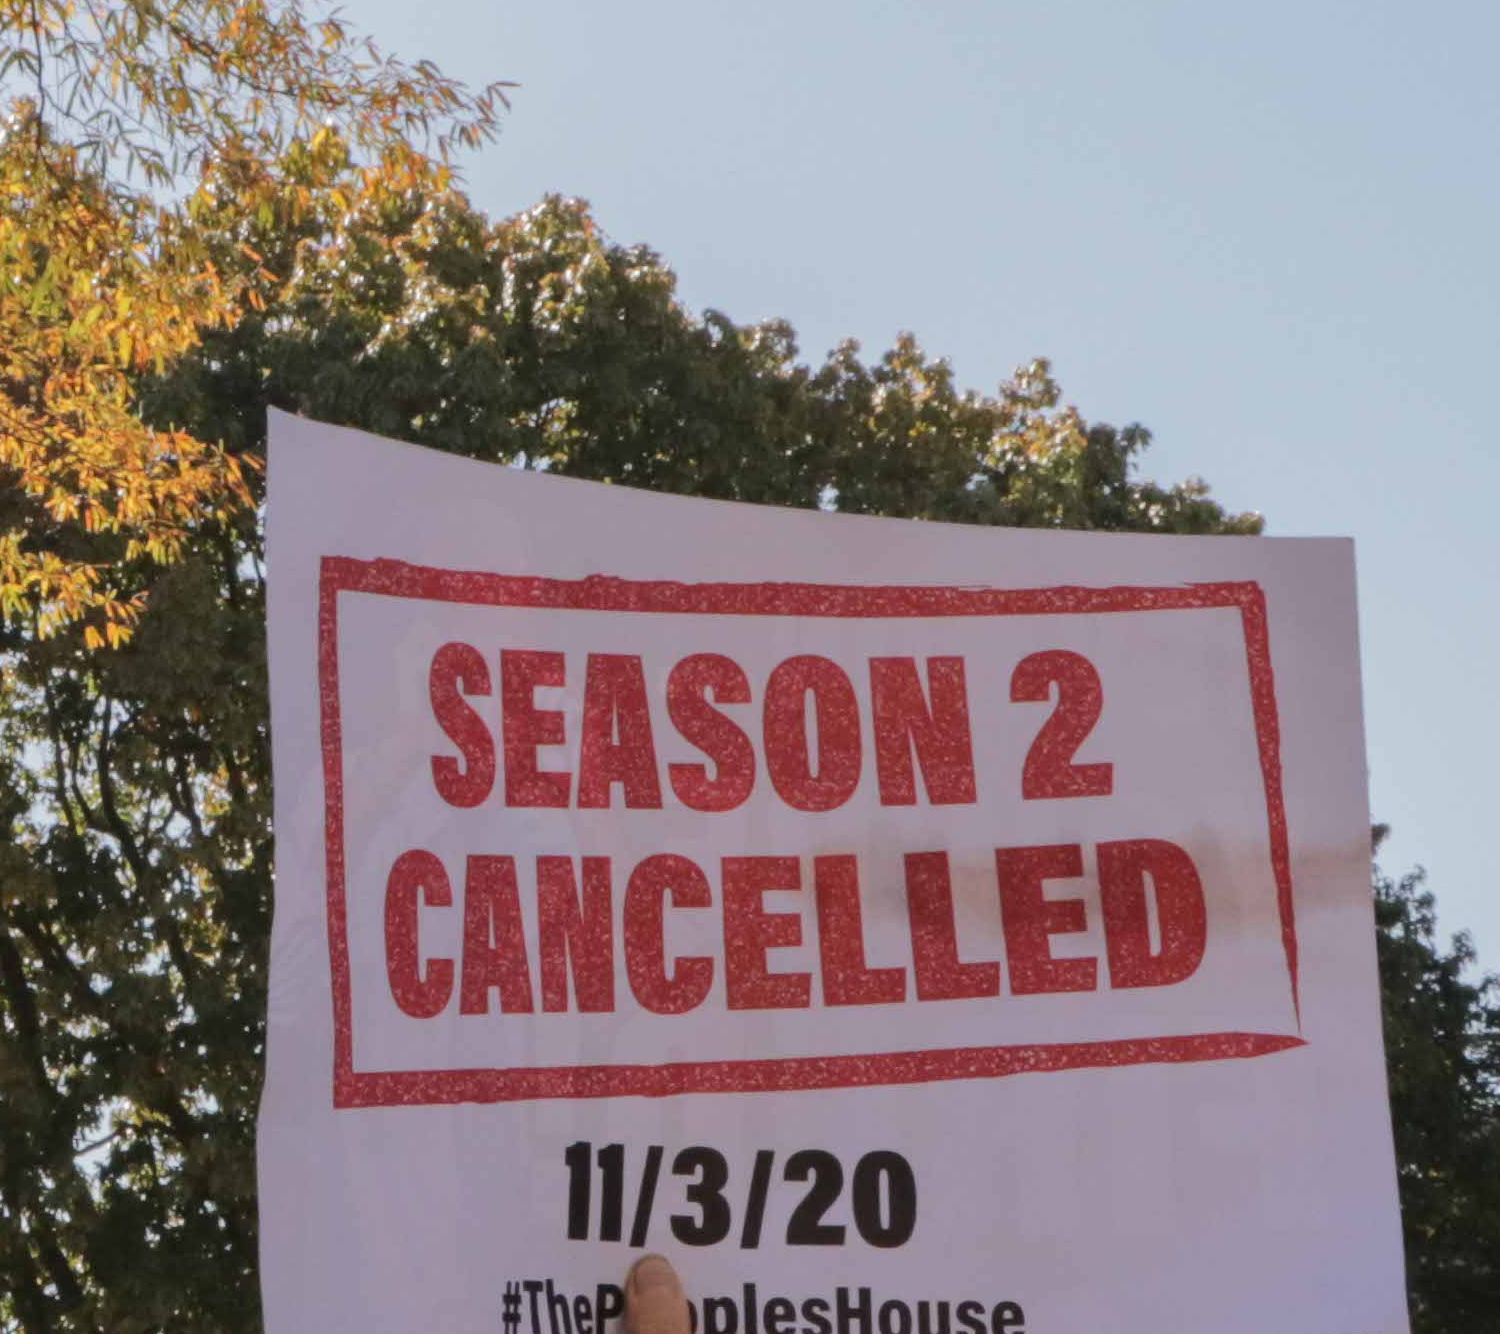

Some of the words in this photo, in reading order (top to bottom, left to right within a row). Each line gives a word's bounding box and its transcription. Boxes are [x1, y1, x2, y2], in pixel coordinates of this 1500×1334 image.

[428, 640, 978, 814] SEASON
[1009, 649, 1115, 802] 2
[384, 837, 1209, 1020] CANCELLED
[564, 1141, 917, 1250] 11/3/20
